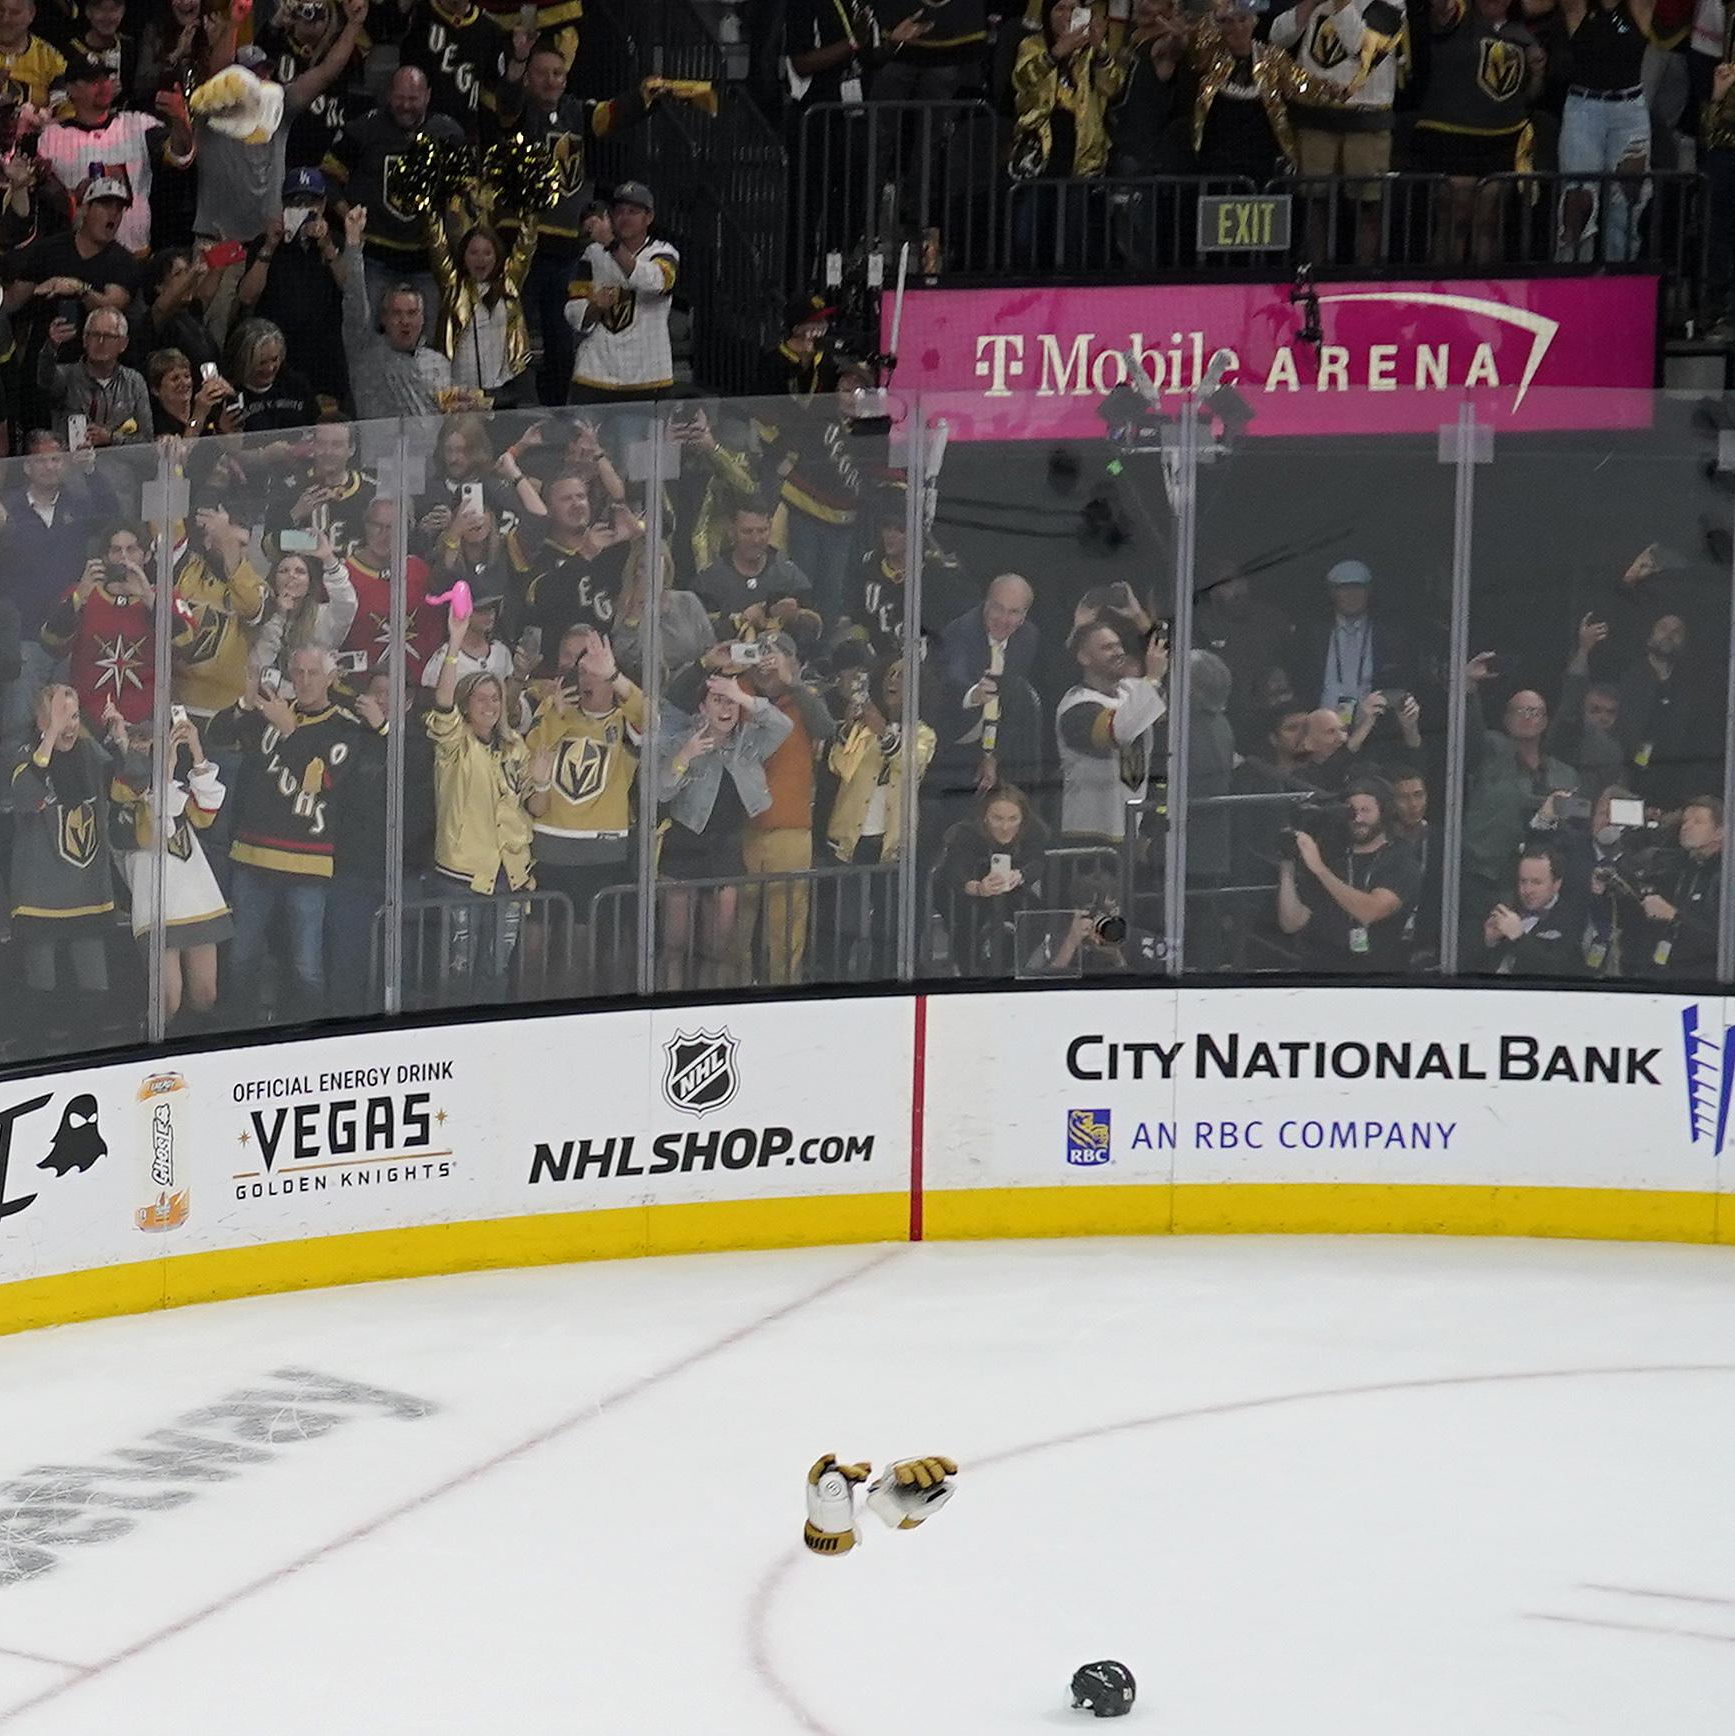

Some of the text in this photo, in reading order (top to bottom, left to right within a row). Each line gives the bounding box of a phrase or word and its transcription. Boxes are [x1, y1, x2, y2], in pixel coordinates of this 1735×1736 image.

[1217, 202, 1275, 245] EXIT
[1263, 342, 1501, 393] ARENA
[232, 1060, 455, 1103] OFFICIAL ENERGY DRINK
[678, 1041, 726, 1102] NHL
[249, 1092, 431, 1173] VEGAS
[1131, 1120, 1458, 1150] AN RBC COMPANY
[528, 1126, 875, 1184] NHLSHOP.COM
[1069, 1147, 1109, 1164] RBC
[235, 1161, 450, 1201] GOLDEN KNIGHTS
